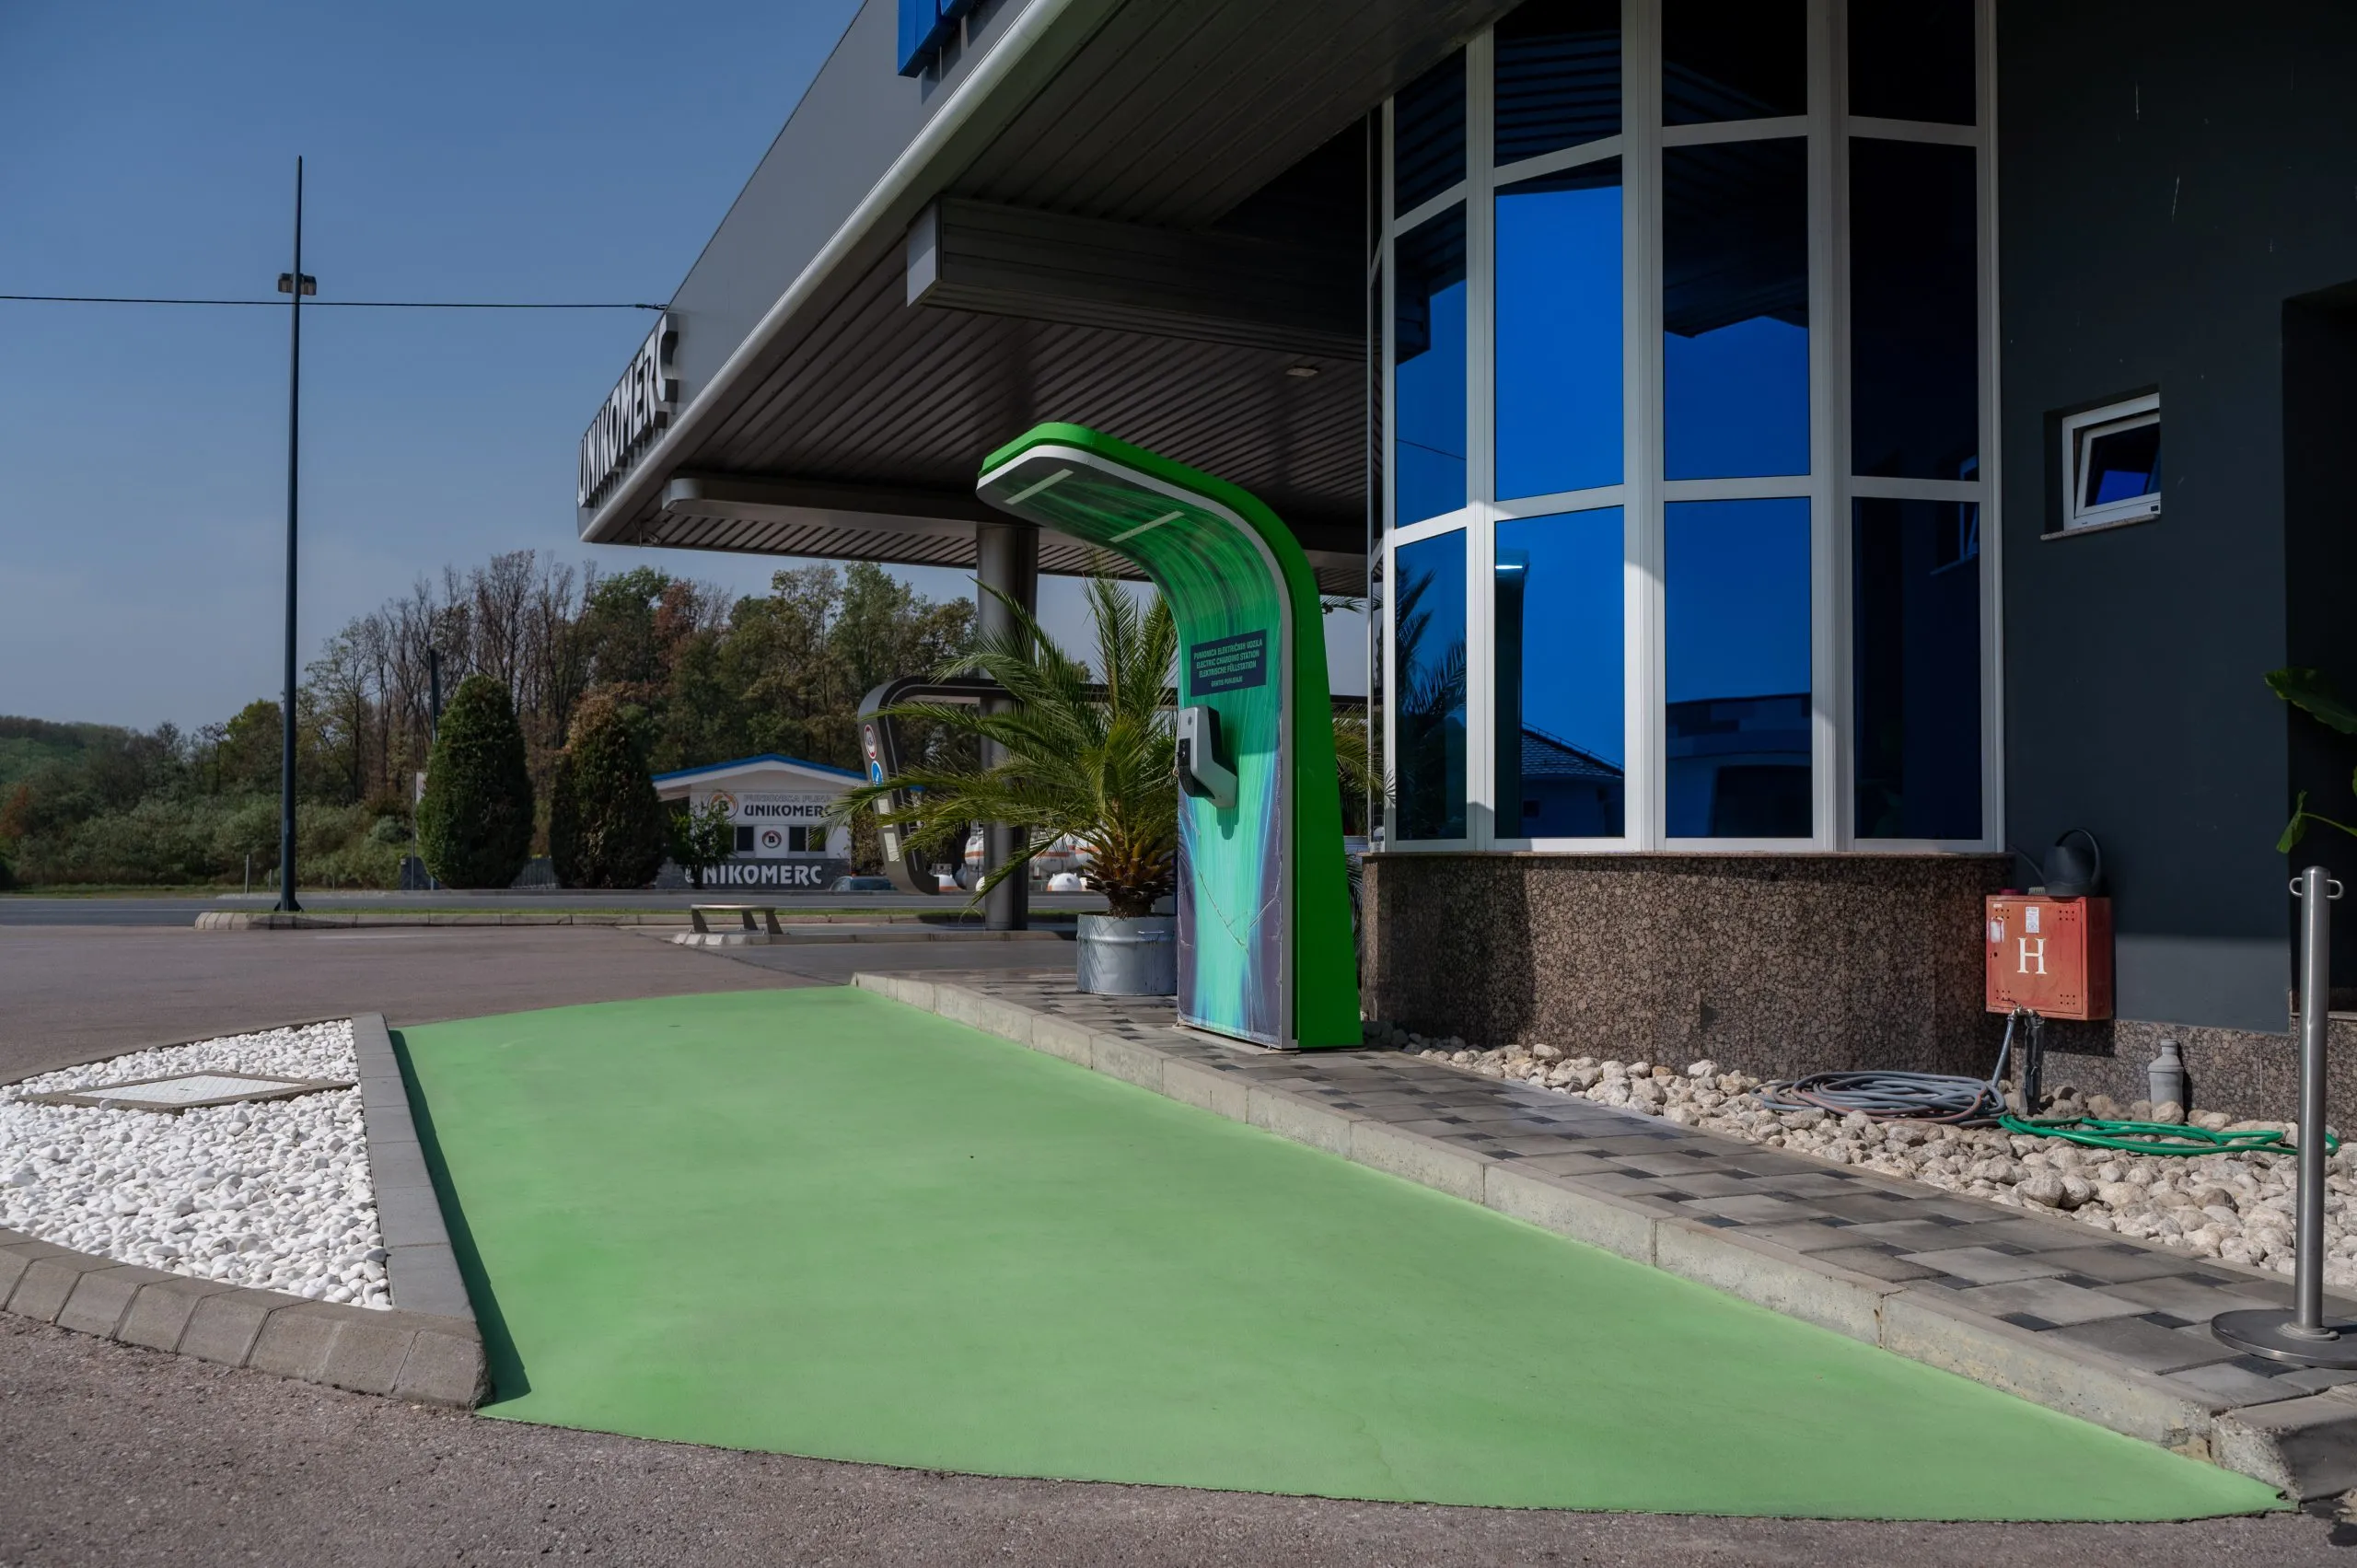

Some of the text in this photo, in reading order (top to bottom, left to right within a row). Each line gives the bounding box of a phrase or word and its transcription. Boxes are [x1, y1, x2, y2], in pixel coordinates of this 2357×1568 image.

[577, 313, 678, 507] UNIKOMERC
[1196, 649, 1260, 669] ELECTRIC CHARGING STATION
[2017, 937, 2048, 975] H
